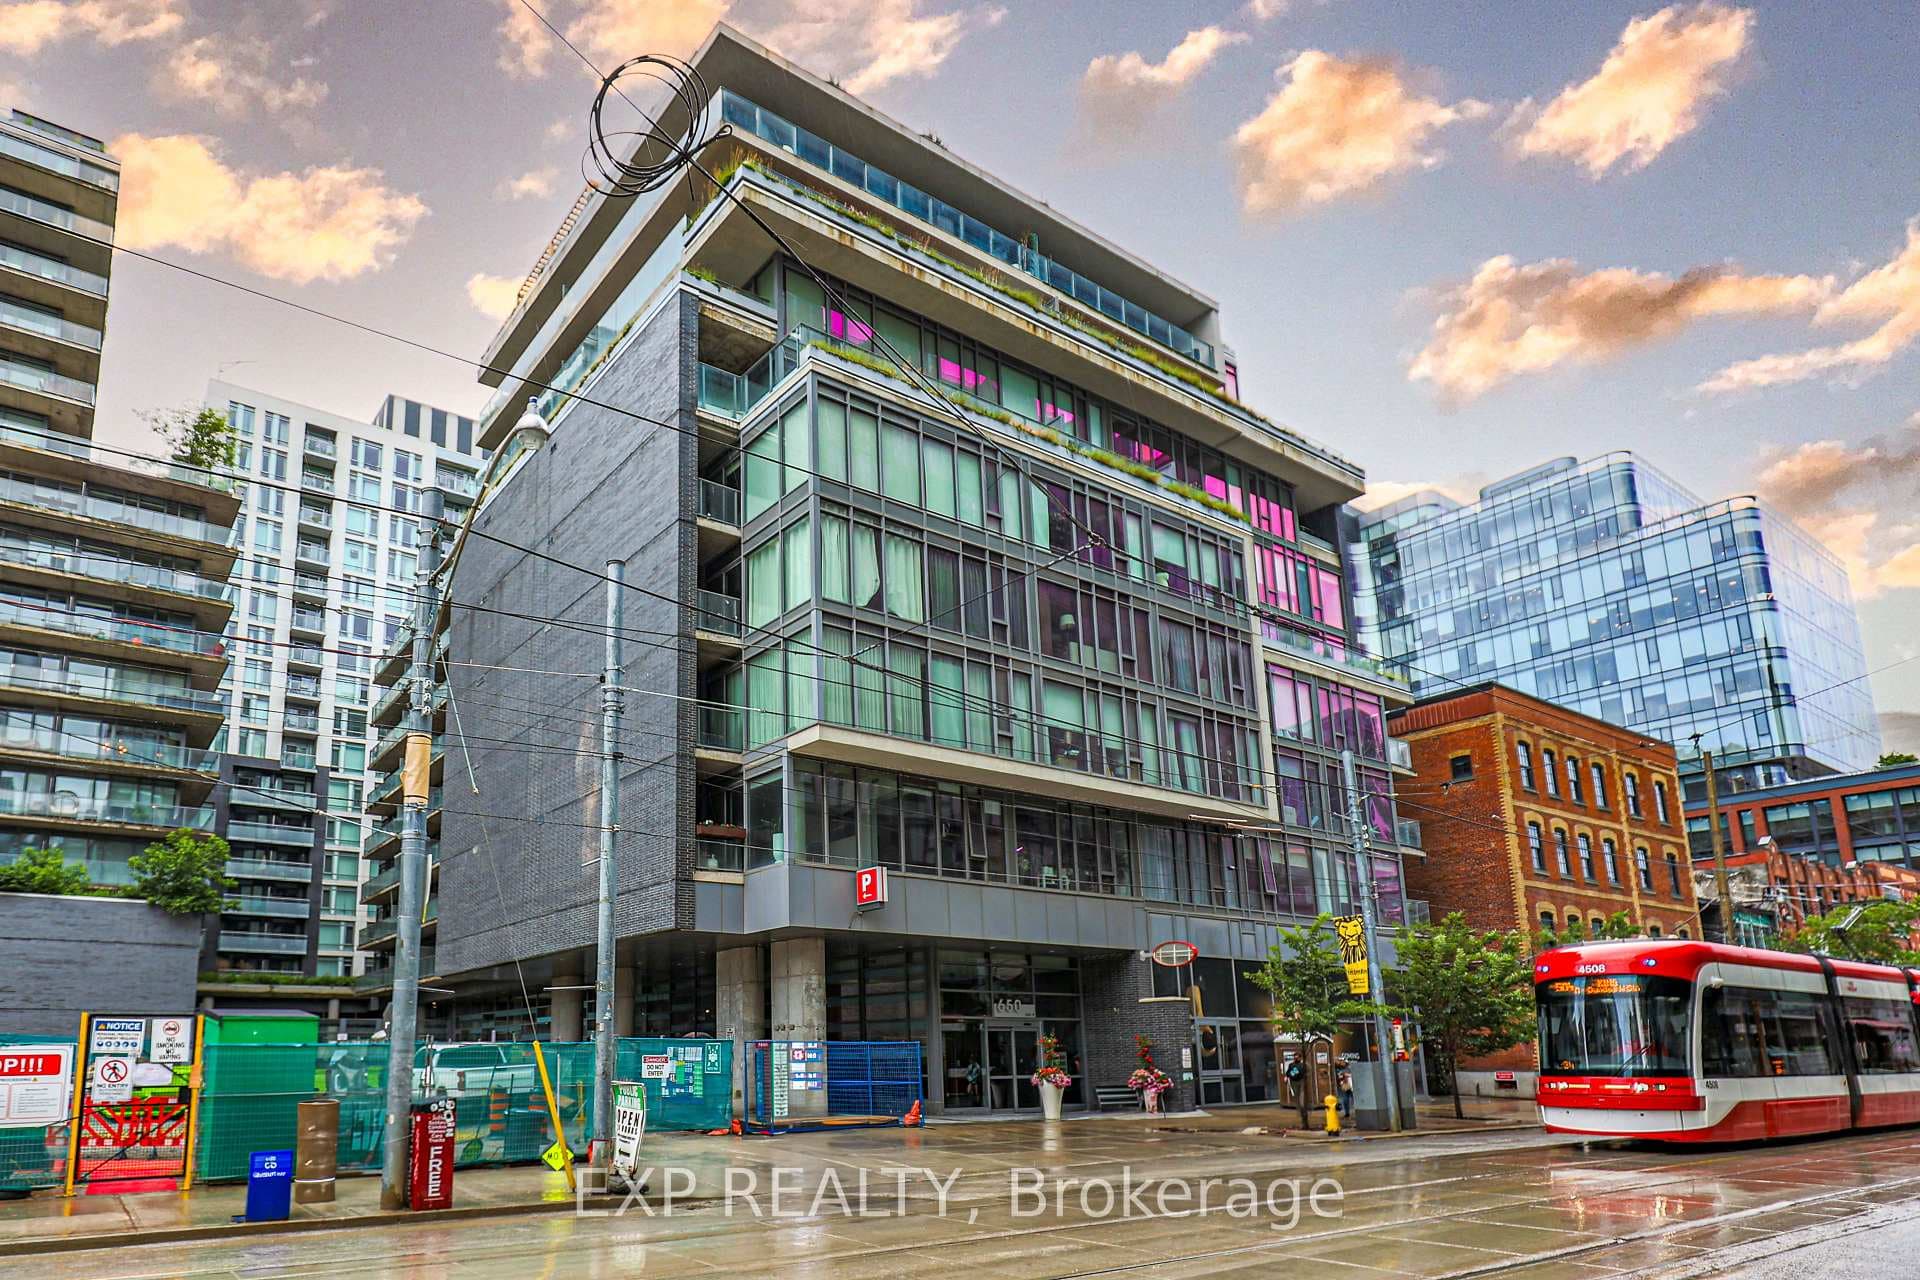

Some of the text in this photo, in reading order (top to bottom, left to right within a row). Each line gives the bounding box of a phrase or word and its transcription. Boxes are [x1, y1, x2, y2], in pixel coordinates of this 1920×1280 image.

[862, 873, 872, 892] P
[1579, 963, 1606, 974] 4508
[998, 998, 1022, 1011] 650
[106, 1022, 142, 1031] NOTICE
[0, 1057, 43, 1073] P!!!
[617, 1108, 640, 1127] OPEN
[427, 1146, 443, 1197] FREE
